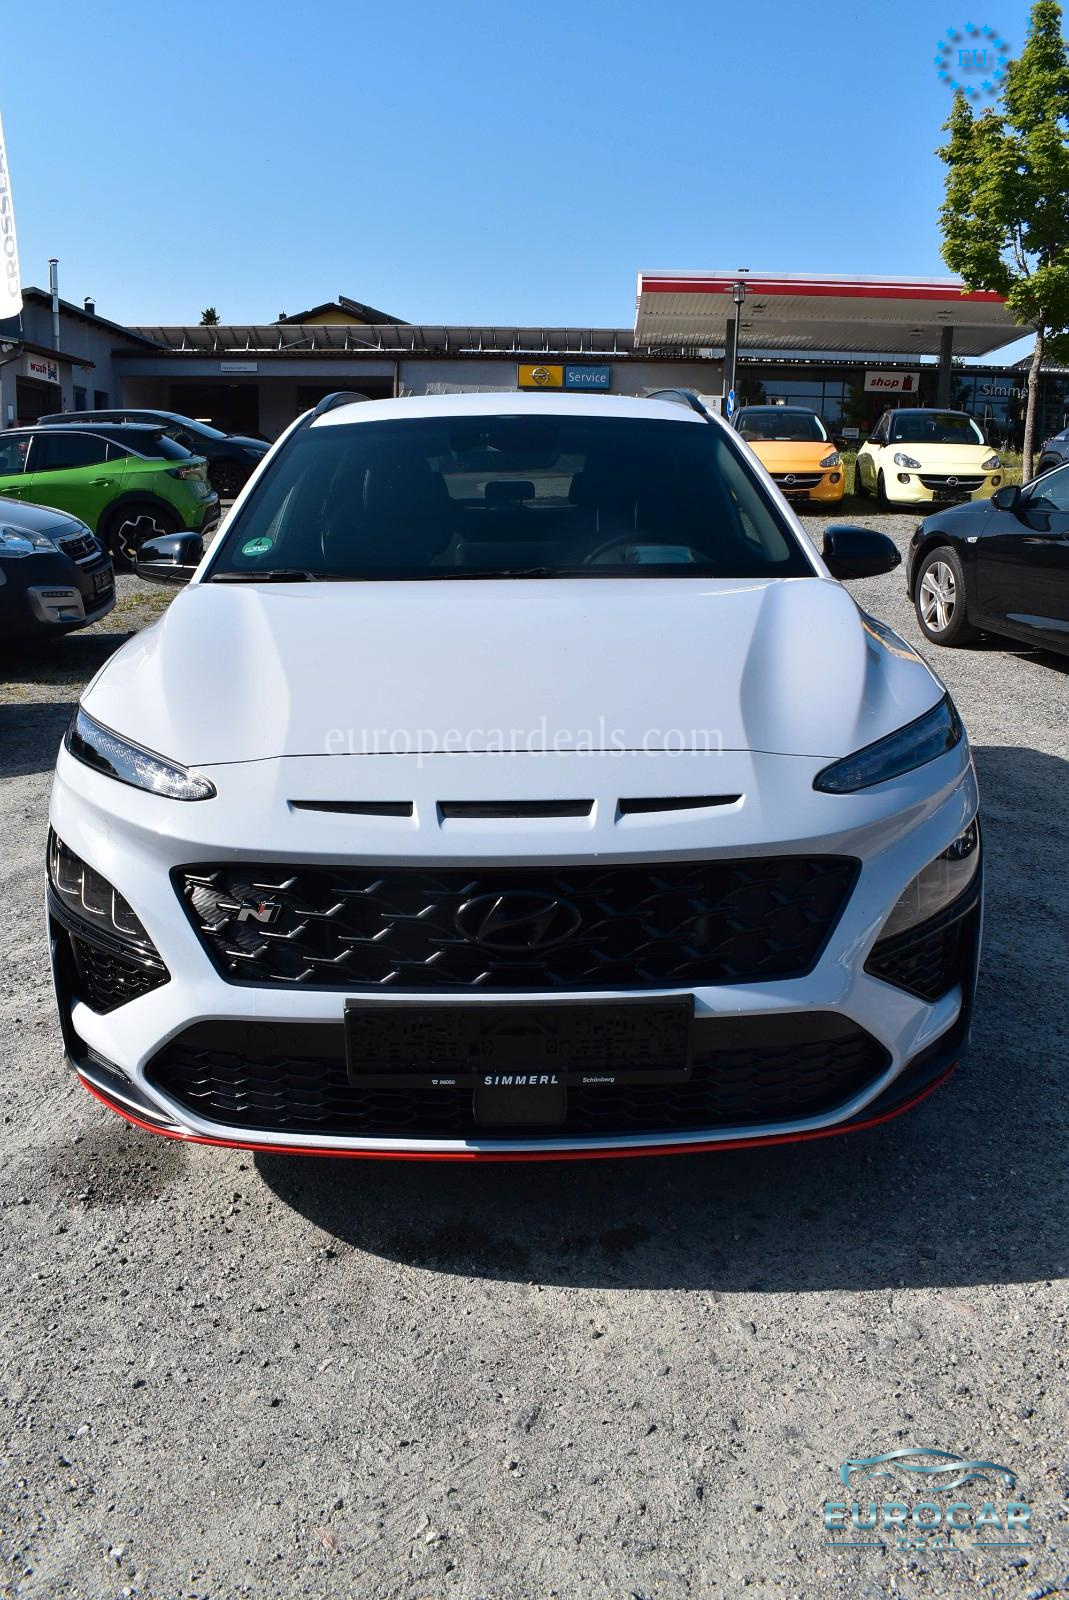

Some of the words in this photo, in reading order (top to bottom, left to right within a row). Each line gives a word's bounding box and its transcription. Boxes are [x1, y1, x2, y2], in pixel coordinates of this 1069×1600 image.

[568, 372, 607, 383] Service
[870, 377, 899, 389] shop
[981, 384, 1029, 398] Simme
[484, 1075, 558, 1086] SIMMERL
